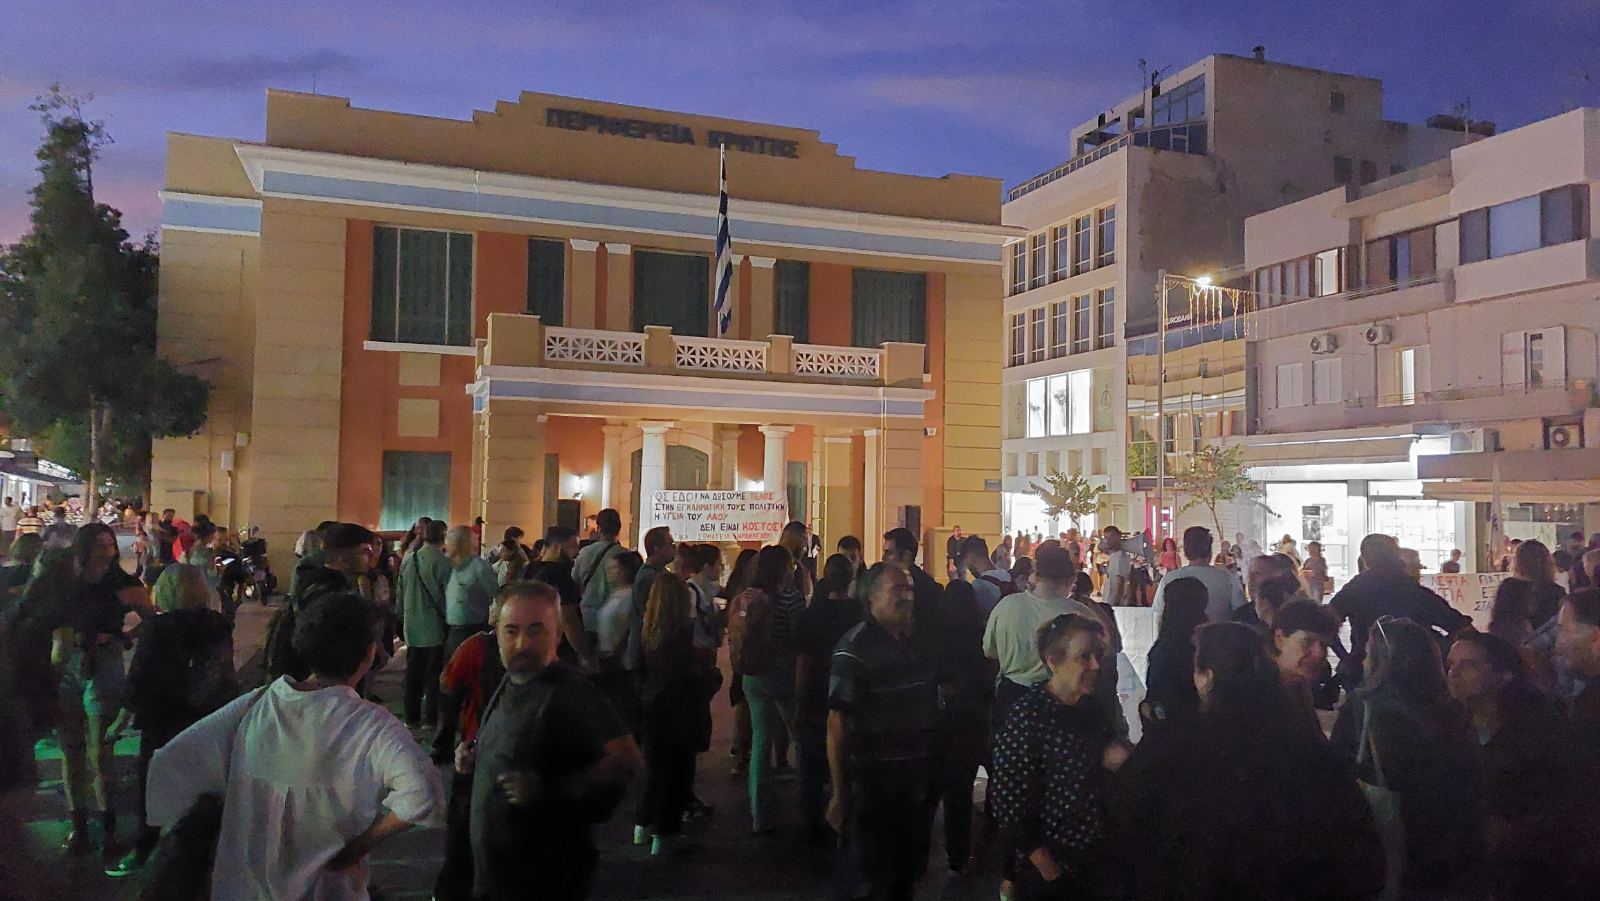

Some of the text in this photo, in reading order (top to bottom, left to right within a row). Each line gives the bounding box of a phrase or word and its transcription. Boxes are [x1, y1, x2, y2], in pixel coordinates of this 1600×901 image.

[713, 492, 746, 501] ΔΩΣΟΥΜΕ
[750, 492, 775, 500] ΤΕΛΟΣ
[655, 503, 785, 511] ΣΤΗΝ ΕΓΚΛΗΜΑΤΙΚΗ ΤΟΥΣ ΠΟΛΙΤΙΚΗ
[662, 512, 684, 520] ΥΓΕΙΑ
[700, 523, 716, 531] ΔΕΝ
[720, 523, 739, 531] ΕΙΝΑΙ
